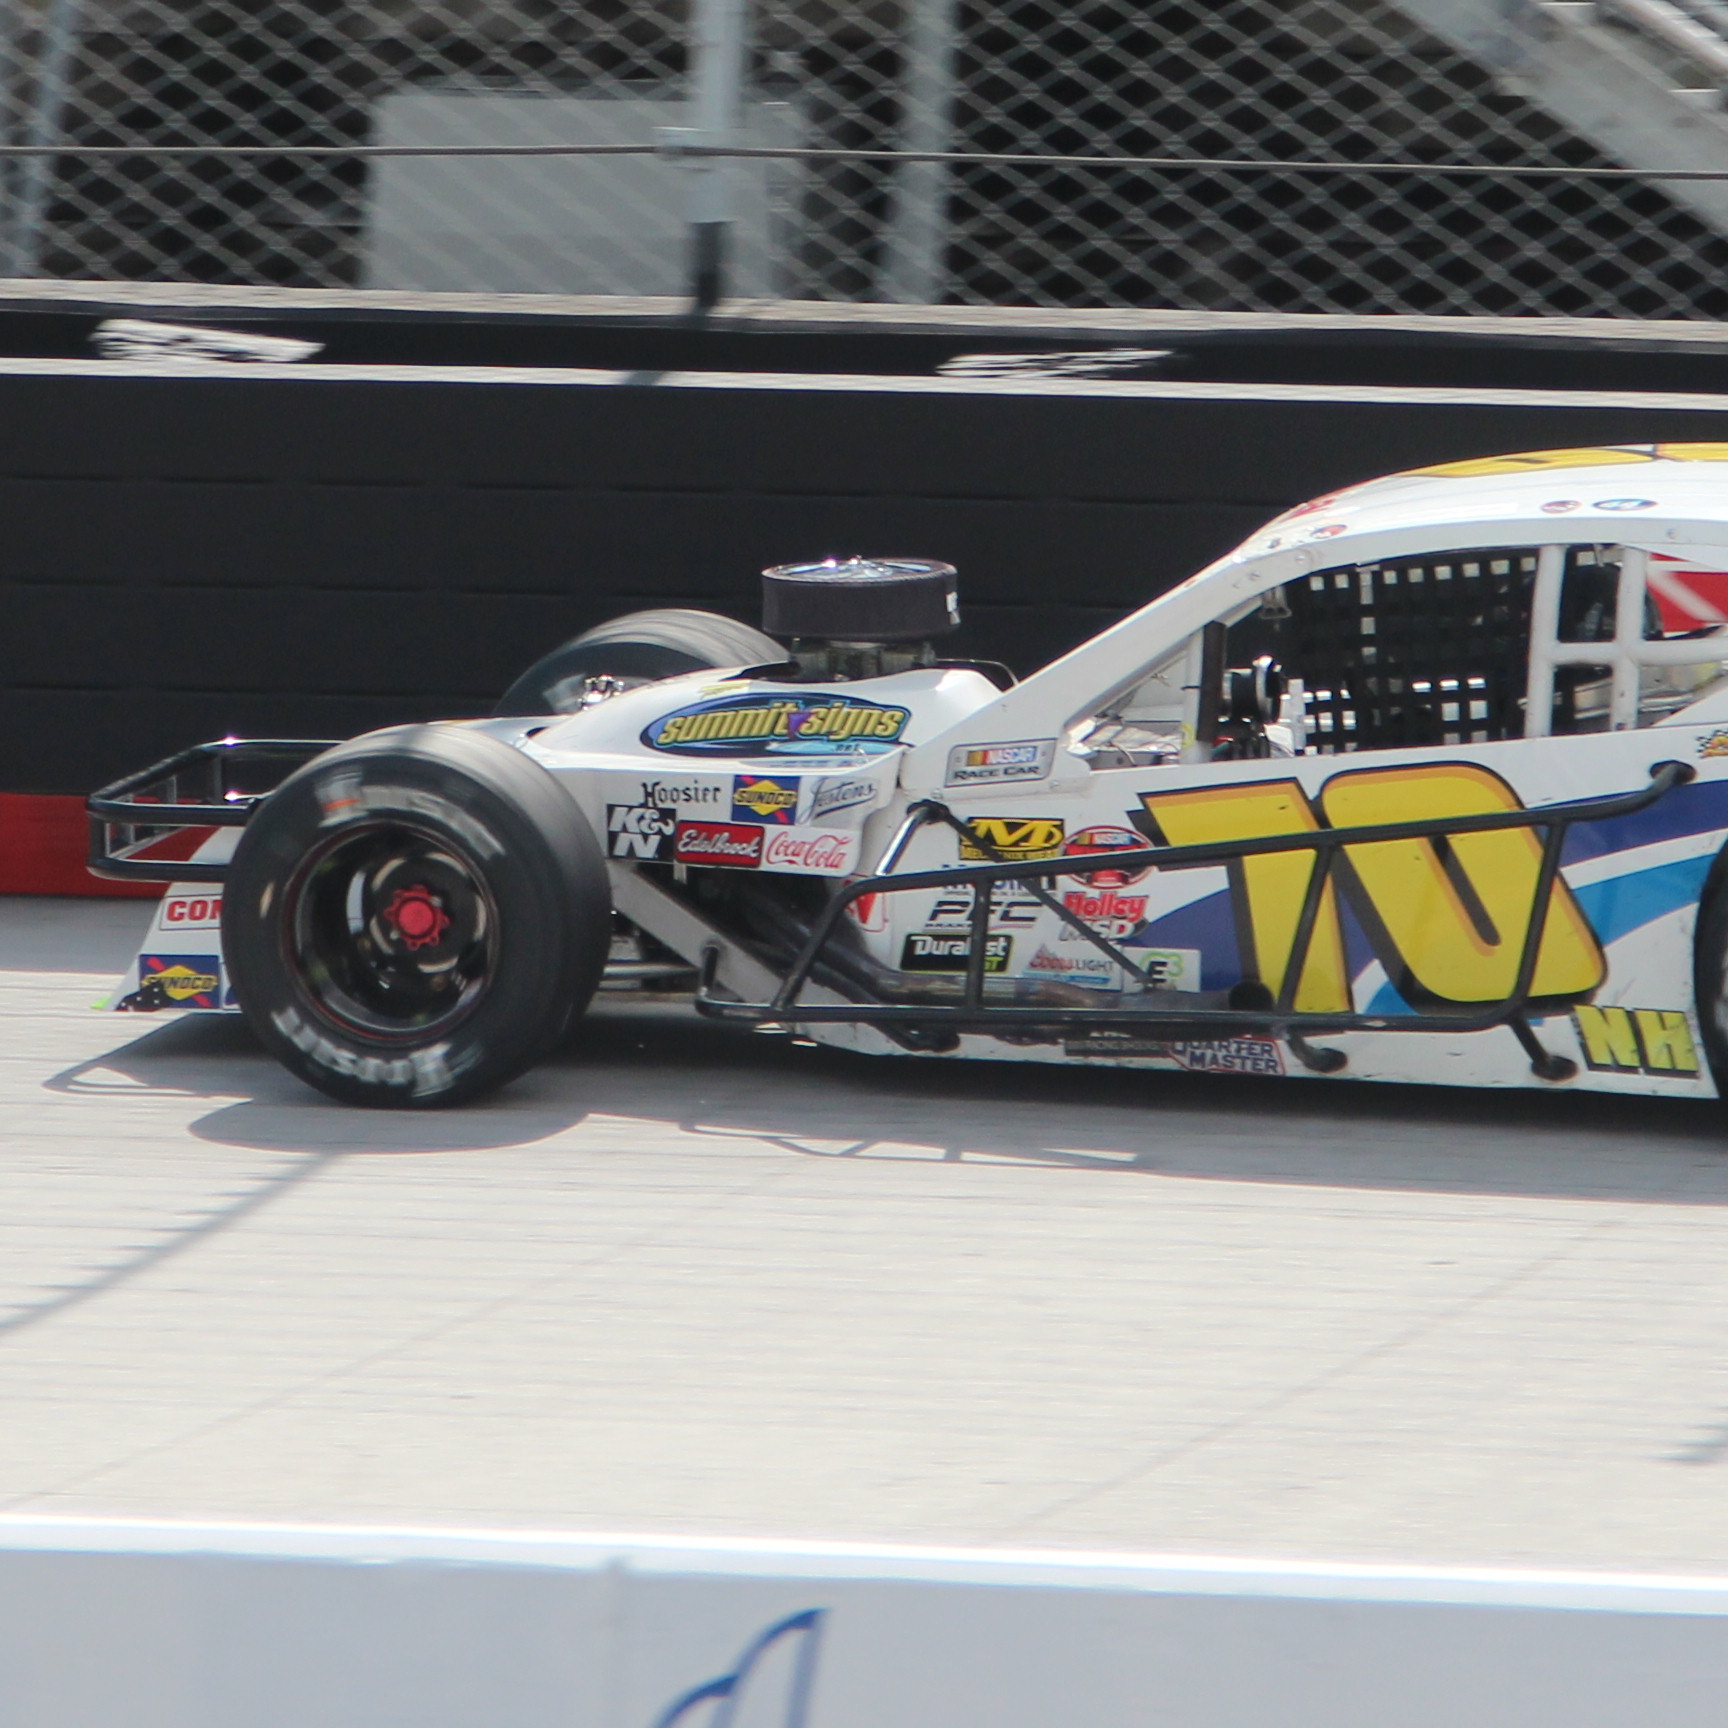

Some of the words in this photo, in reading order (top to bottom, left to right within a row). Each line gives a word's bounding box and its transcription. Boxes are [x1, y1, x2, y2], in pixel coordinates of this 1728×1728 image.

[658, 702, 800, 746] summit
[802, 702, 905, 740] signs
[640, 782, 721, 808] Hoosier
[735, 788, 796, 805] SUNOCO
[677, 825, 760, 859] Edelbrock
[1064, 893, 1149, 923] Holley
[910, 936, 1008, 956] Duralst
[1573, 1005, 1700, 1078] NH
[1188, 1050, 1279, 1073] MASTER
